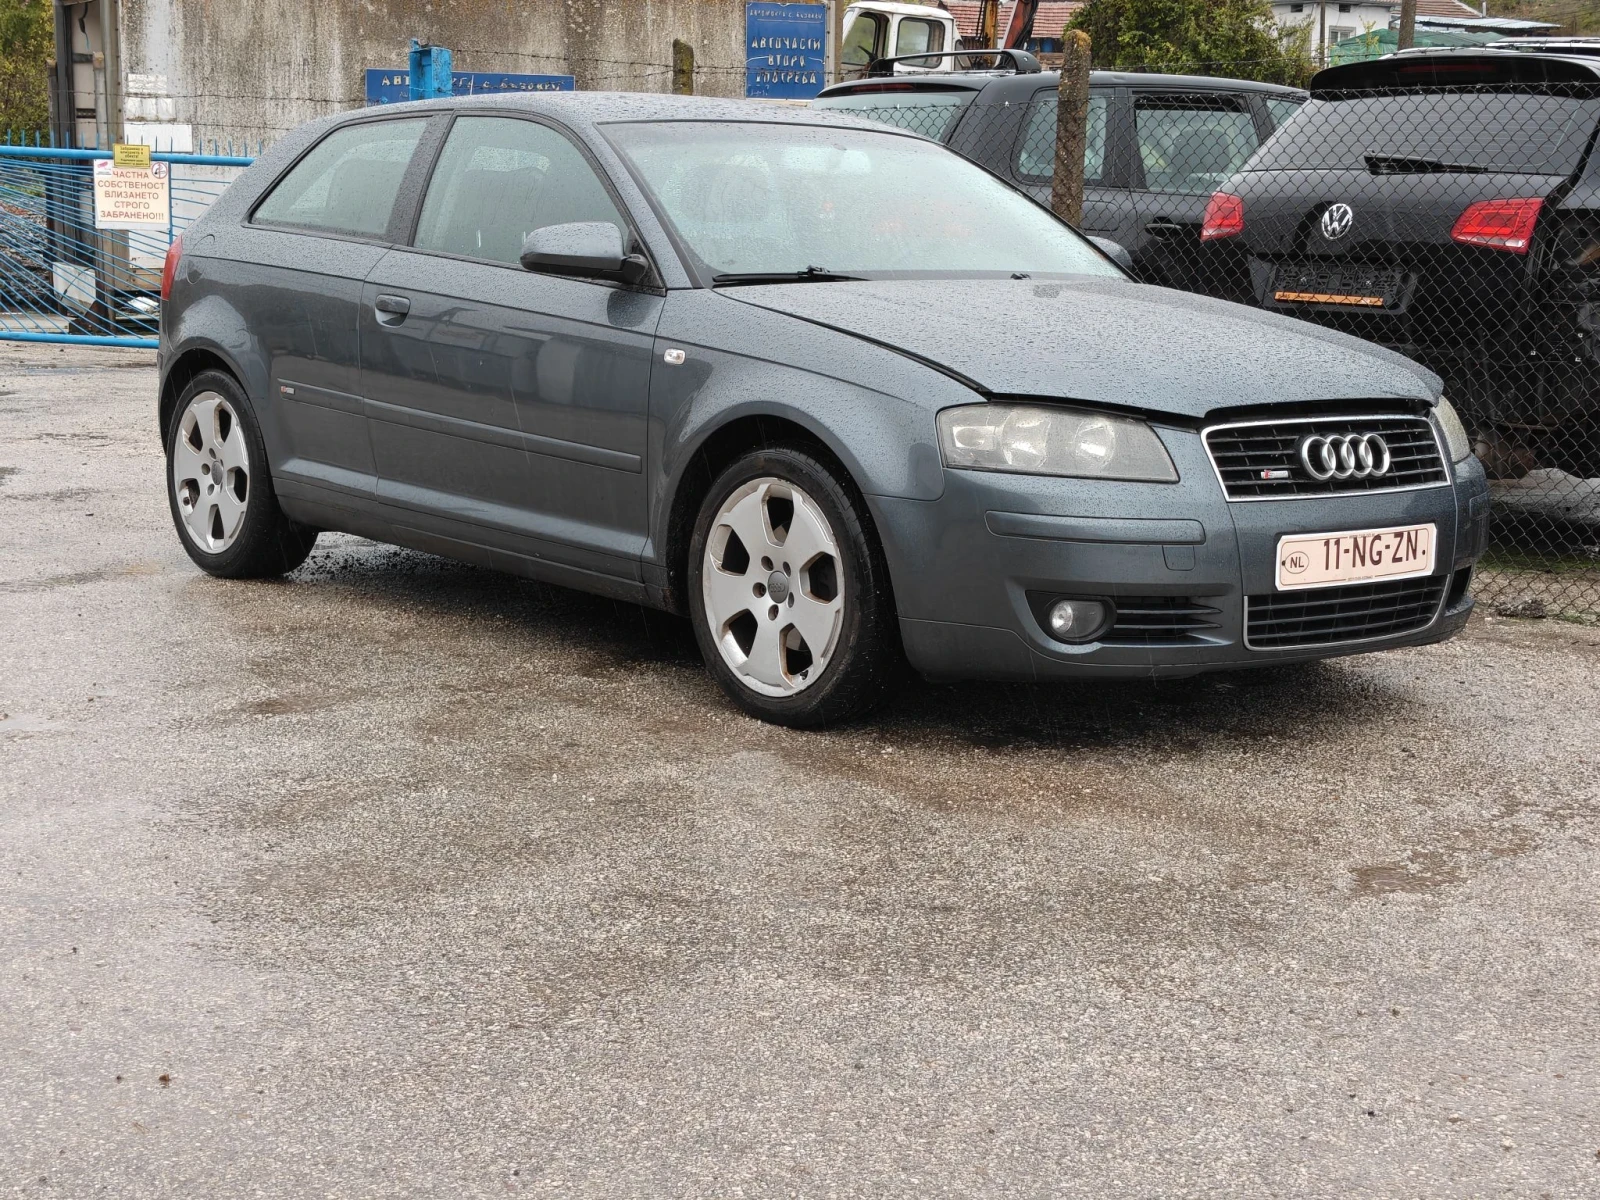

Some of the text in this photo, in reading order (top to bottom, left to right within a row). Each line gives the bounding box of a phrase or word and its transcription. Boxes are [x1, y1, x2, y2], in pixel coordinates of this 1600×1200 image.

[752, 37, 820, 50] АВТОЧАСТИ
[113, 170, 149, 179] ЧАСТНА
[97, 180, 165, 190] СОБСТВЕНОСТ
[104, 190, 159, 200] ВЛИЗАНЕТО
[114, 201, 150, 210] СТРОГО
[100, 210, 164, 220] ЗАБРАНЕНО!!!
[1323, 529, 1418, 571] 11-NG-ZN
[1289, 556, 1305, 569] NL
